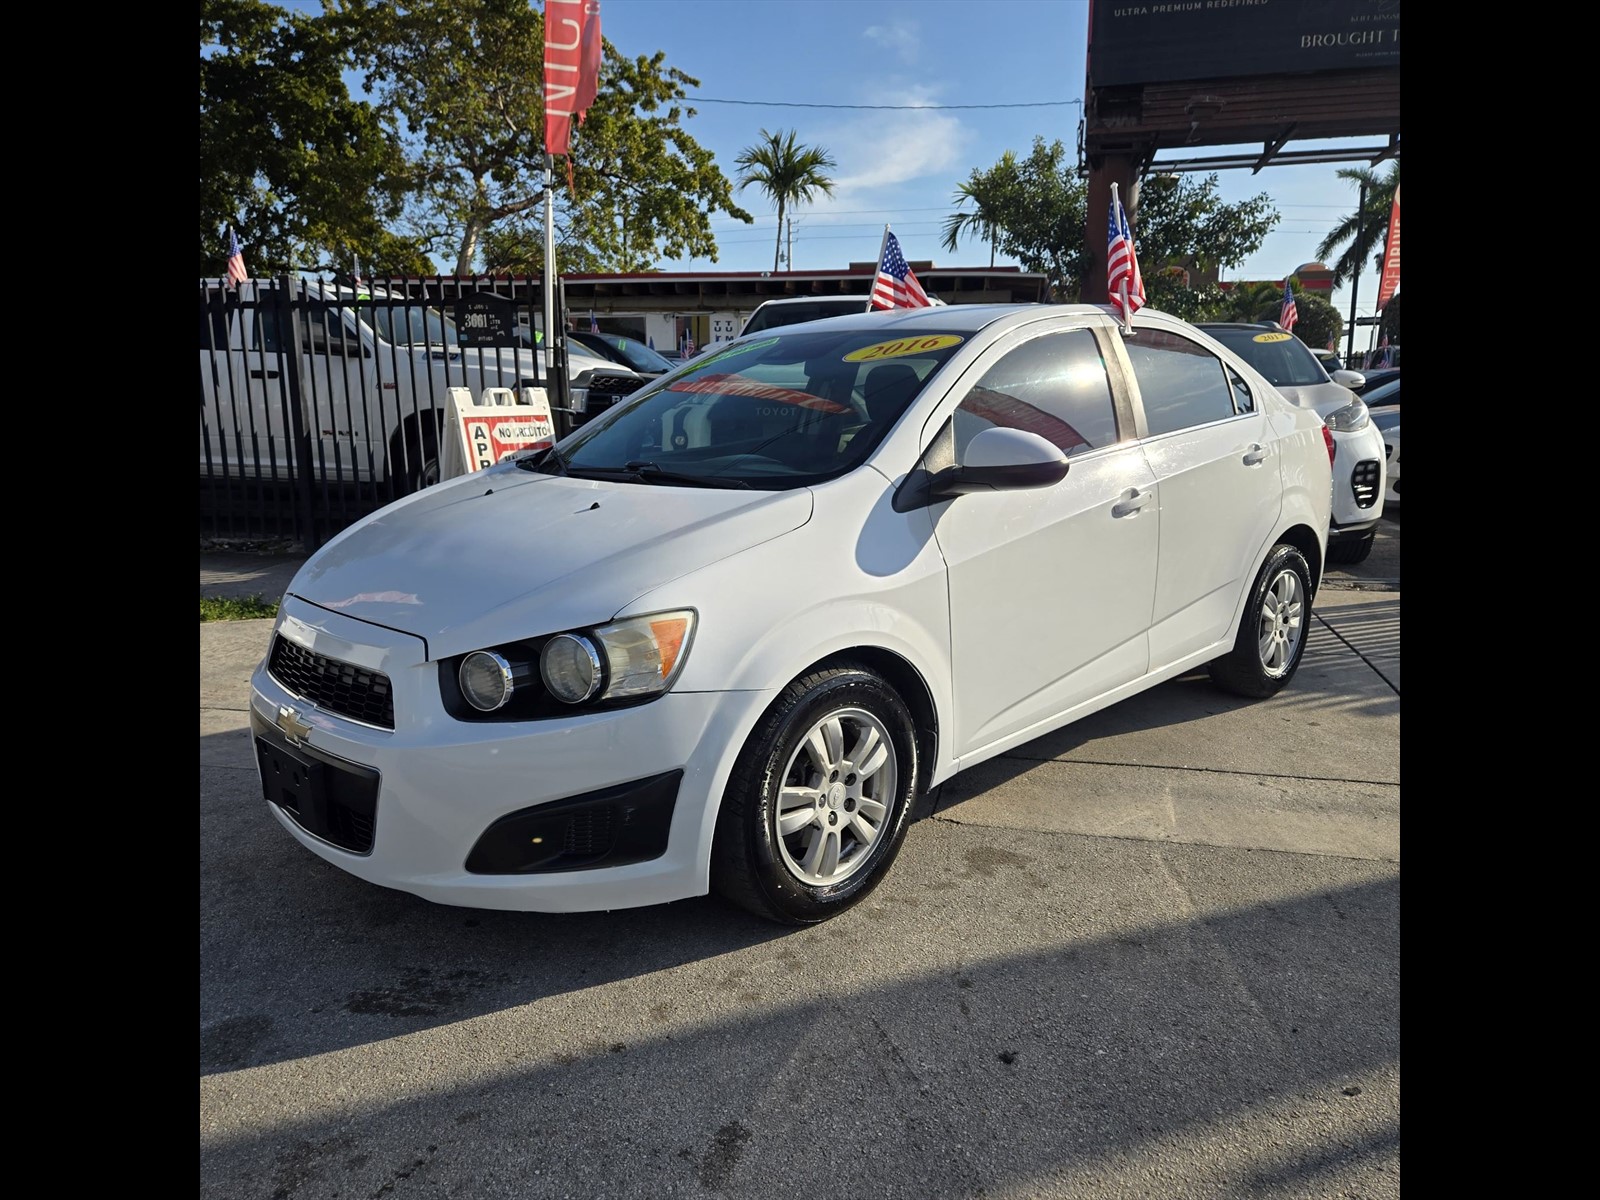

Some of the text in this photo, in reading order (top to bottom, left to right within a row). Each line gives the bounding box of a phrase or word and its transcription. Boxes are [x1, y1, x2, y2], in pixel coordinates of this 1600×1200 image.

[1114, 7, 1147, 17] ULTRA
[1152, 3, 1201, 13] PREMIUM
[1301, 30, 1384, 48] BROUGHT
[544, 0, 581, 117] NIC
[860, 335, 944, 360] 2016
[498, 426, 547, 438] NO REDITO
